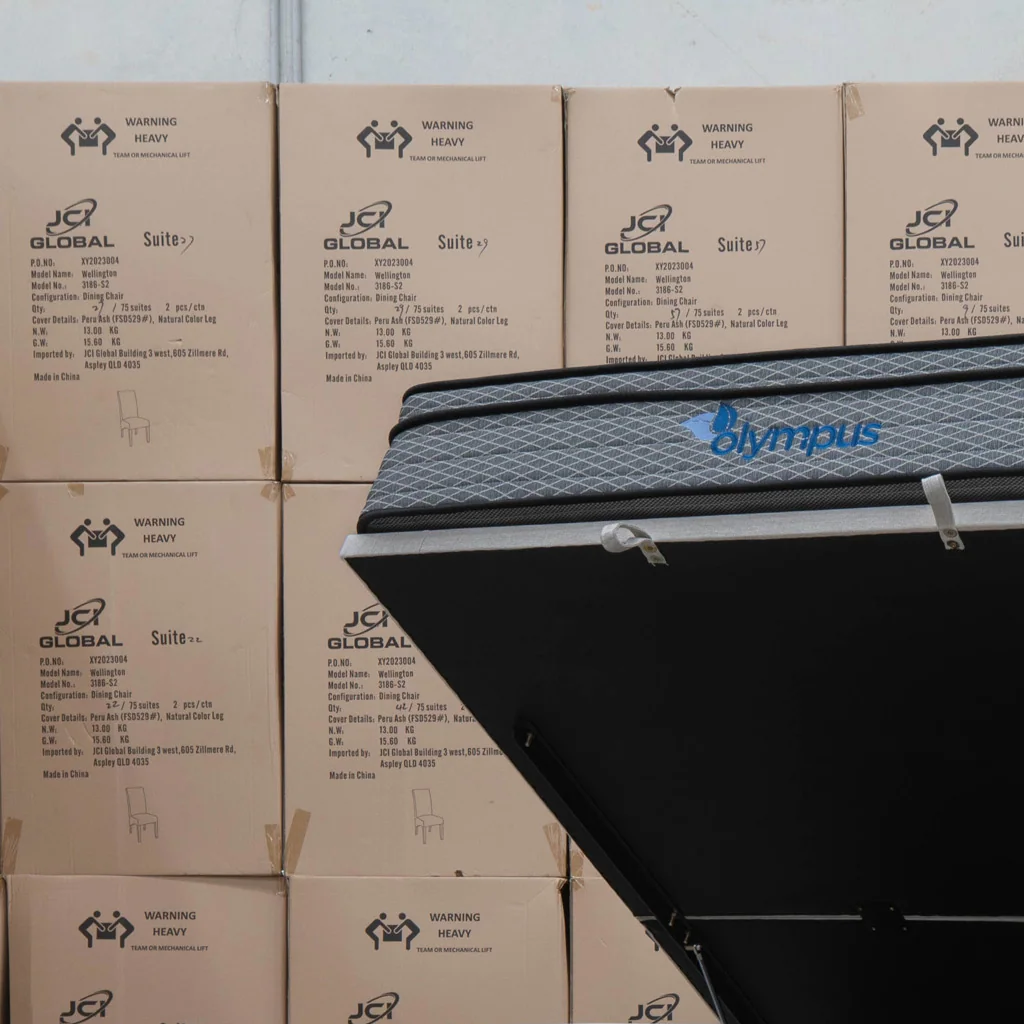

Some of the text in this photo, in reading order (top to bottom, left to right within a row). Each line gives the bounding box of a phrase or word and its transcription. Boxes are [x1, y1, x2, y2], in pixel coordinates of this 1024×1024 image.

[125, 117, 177, 126] WARNING
[422, 120, 473, 130] WARNING
[702, 123, 753, 132] WARNING
[134, 134, 168, 143] HEAVY
[430, 137, 464, 146] HEAVY
[711, 140, 744, 149] HEAVY
[46, 204, 95, 231] JCI
[340, 206, 389, 232] JCI
[906, 205, 955, 231] JCI
[621, 210, 670, 236] JCI
[30, 236, 115, 249] GLOBAL
[144, 231, 178, 247] Suite
[323, 237, 409, 251] GLOBAL
[438, 234, 472, 249] Suite
[889, 237, 975, 250] GLOBAL
[604, 241, 689, 254] GLOBAL
[718, 237, 752, 252] Suite
[889, 271, 910, 279] Model
[941, 271, 977, 280] Wellington
[376, 294, 398, 303] Dining
[399, 294, 417, 302] Chair
[605, 321, 623, 330] Cover
[655, 321, 670, 329] Peru
[672, 320, 683, 328] Ash
[730, 319, 755, 328] Natural
[757, 319, 775, 328] Color
[776, 319, 788, 329] Leg
[325, 374, 371, 382] Made in China
[134, 517, 185, 527] WARNING
[143, 534, 176, 543] HEAVY
[55, 604, 103, 630] JCI
[39, 635, 123, 648] GLOBAL
[152, 630, 186, 645] Suite
[327, 637, 411, 649] GLOBAL
[90, 656, 128, 664] XY2023004
[40, 669, 60, 677] Model
[91, 668, 126, 677] Wellington
[40, 680, 60, 688] Model
[330, 771, 376, 779] Made in China
[144, 911, 197, 920] WARNING
[429, 913, 480, 922] WARNING
[153, 928, 187, 936] HEAVY
[438, 929, 471, 938] HEAVY
[60, 995, 111, 1021] JCI
[348, 997, 397, 1023] JCI
[628, 999, 677, 1024] JCI
